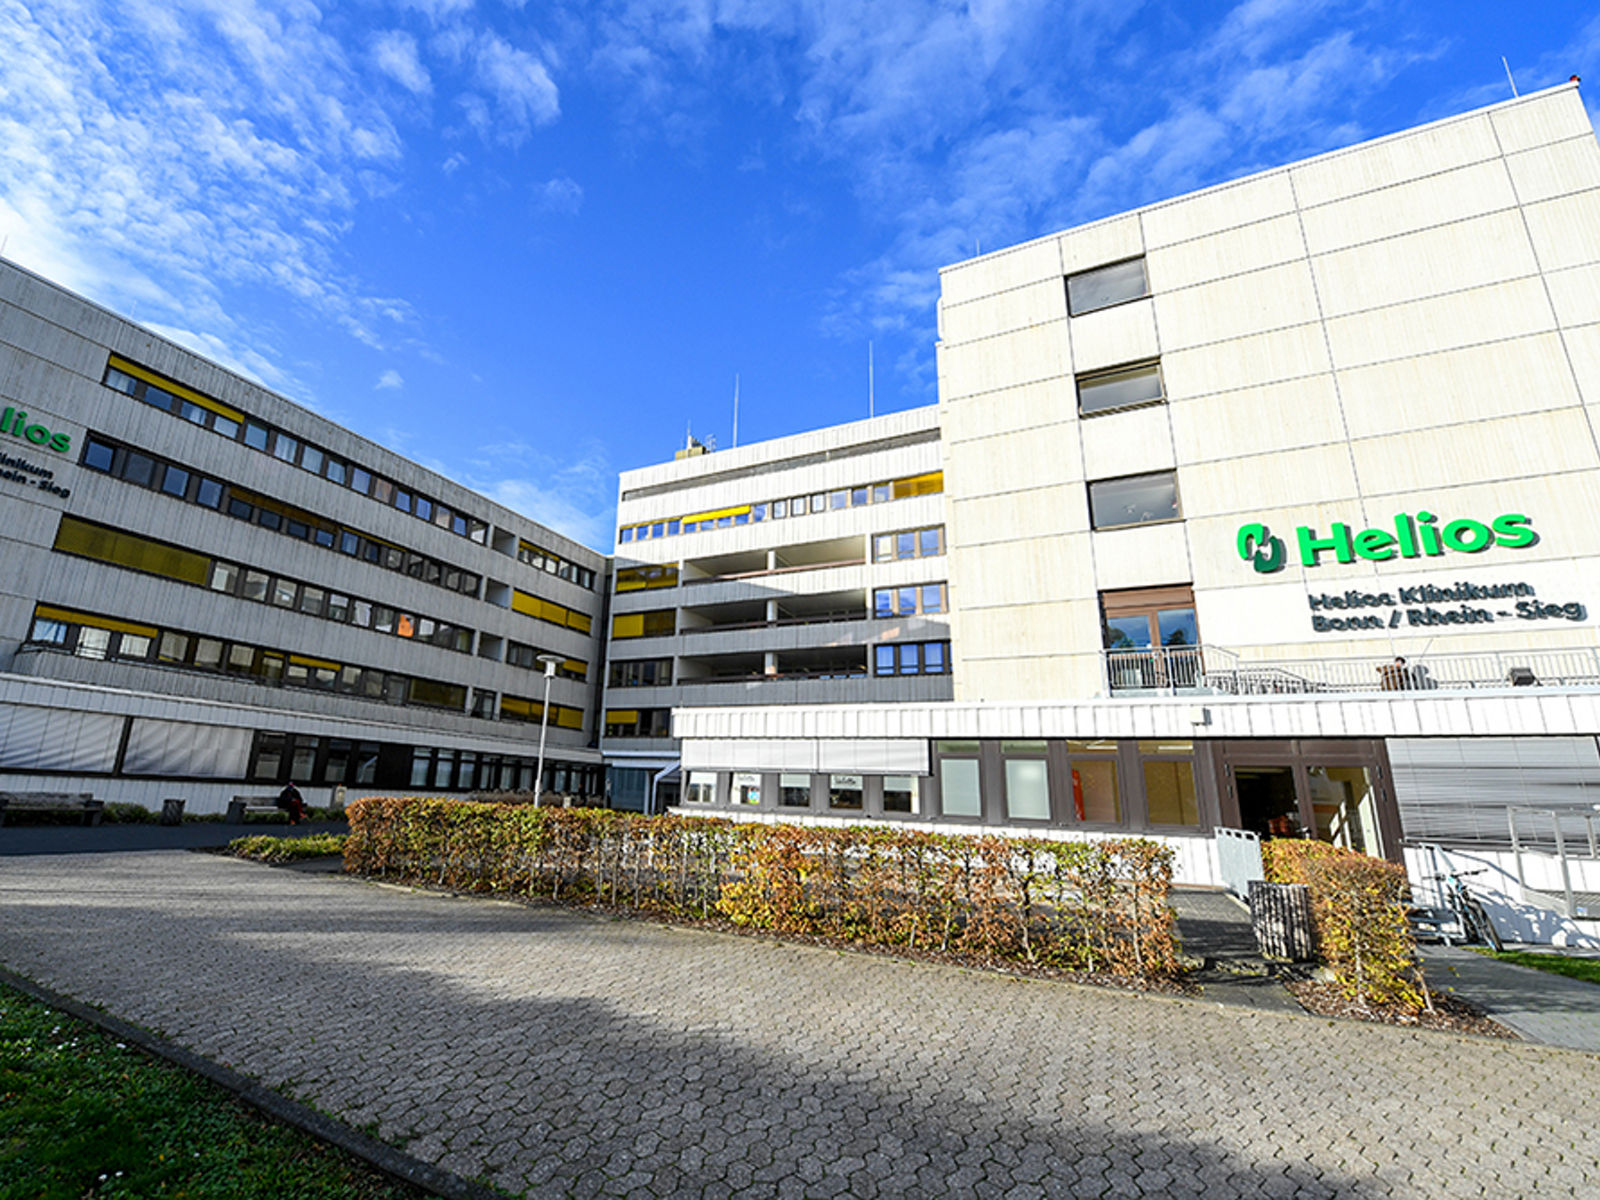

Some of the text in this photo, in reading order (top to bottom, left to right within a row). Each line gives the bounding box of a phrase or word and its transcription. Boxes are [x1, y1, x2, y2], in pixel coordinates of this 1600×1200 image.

[0, 406, 71, 453] lios
[38, 480, 71, 499] Sieg
[1296, 511, 1538, 567] Helios
[1308, 582, 1536, 611] Helios Klinikum
[1311, 615, 1385, 632] Bonn
[1406, 606, 1494, 627] Rhein
[1515, 599, 1588, 622] Sieg
